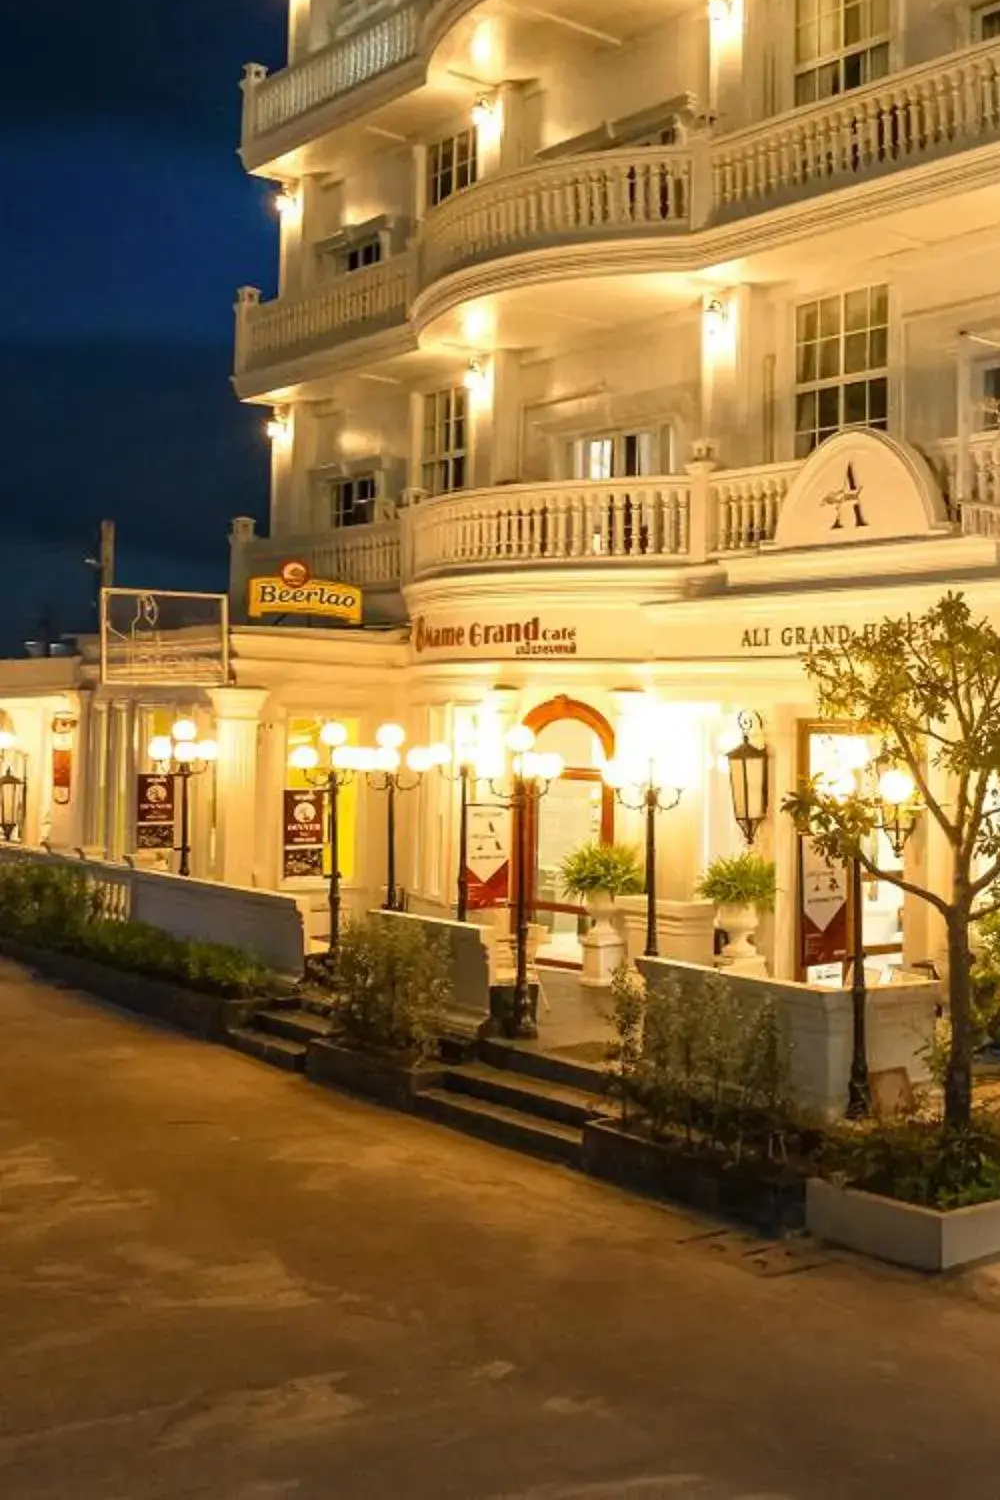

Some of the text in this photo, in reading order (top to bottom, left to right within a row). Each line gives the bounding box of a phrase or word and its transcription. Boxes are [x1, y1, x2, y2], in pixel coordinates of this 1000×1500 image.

[259, 585, 356, 607] Beerlao
[469, 617, 540, 648] Grand
[741, 628, 770, 647] ALI
[780, 624, 850, 646] GRAND
